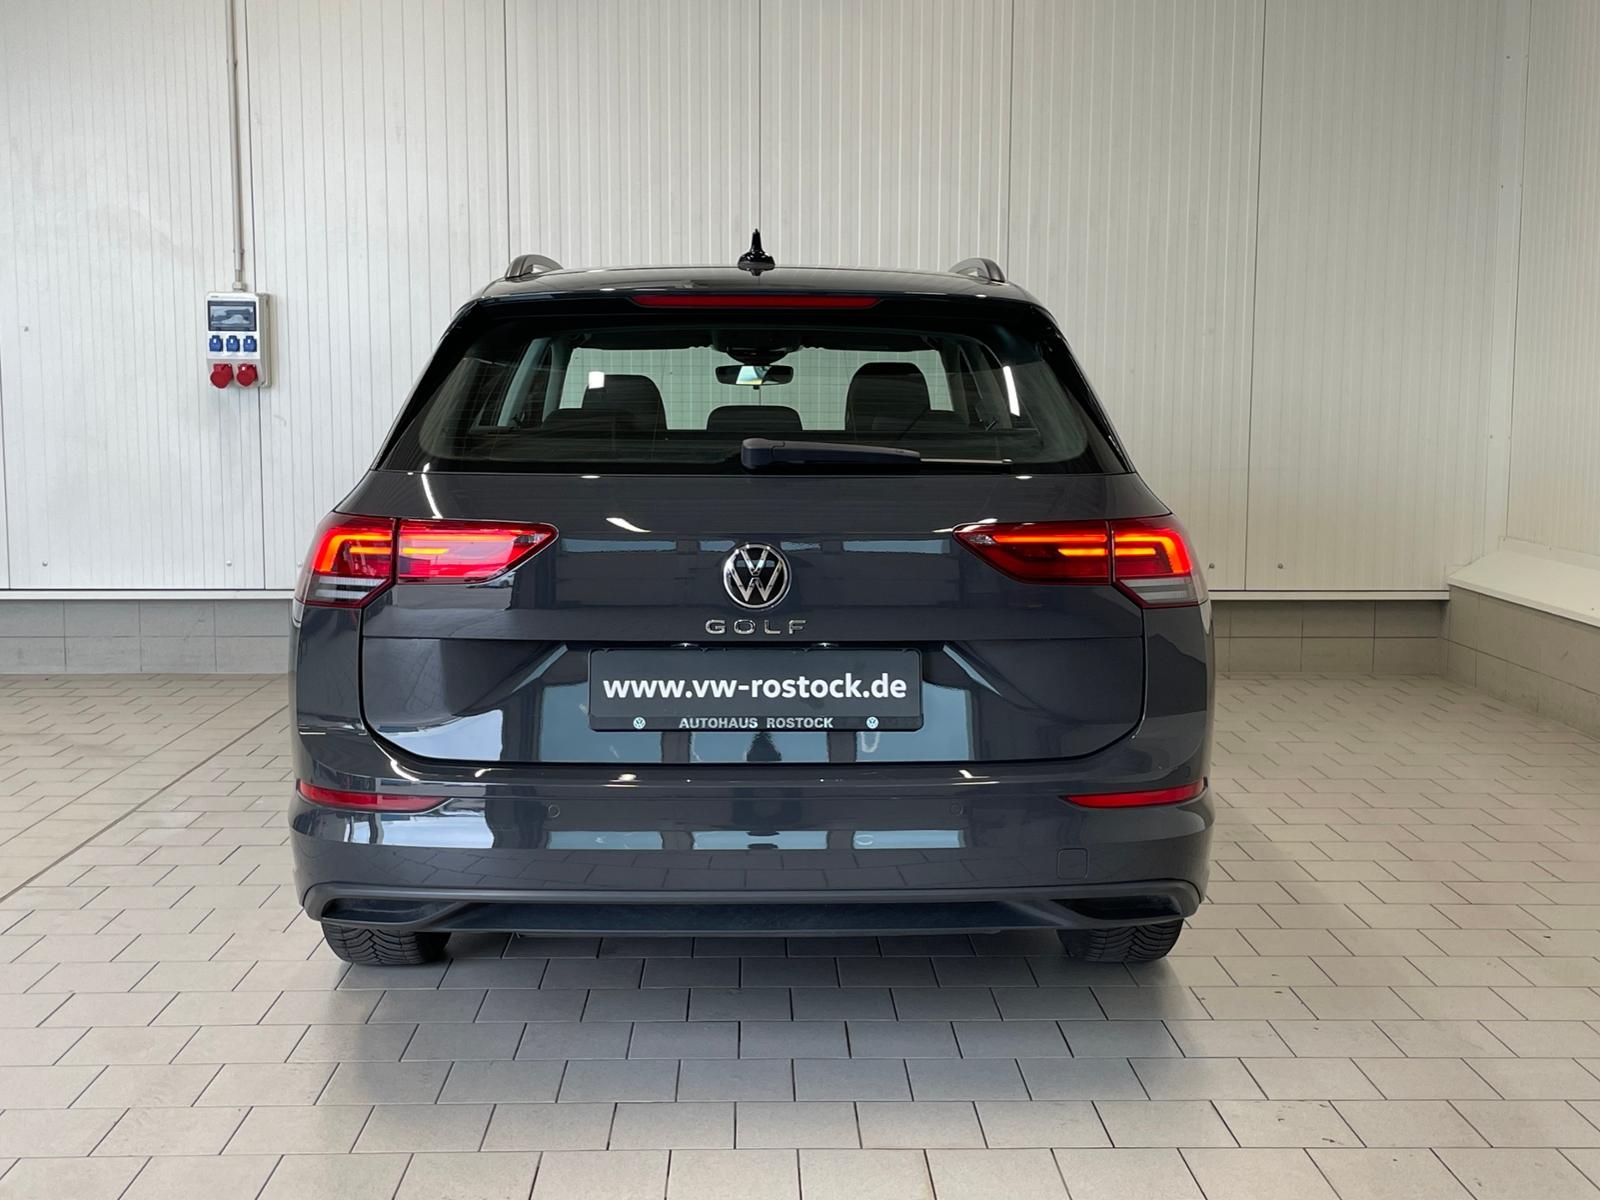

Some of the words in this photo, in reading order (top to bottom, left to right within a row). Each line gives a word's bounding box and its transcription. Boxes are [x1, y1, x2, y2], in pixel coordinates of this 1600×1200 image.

[705, 619, 807, 635] GOLF
[603, 672, 907, 699] www.vw-rostock.de
[679, 717, 758, 729] AUTOHAUS
[767, 717, 834, 729] ROSTOCK
